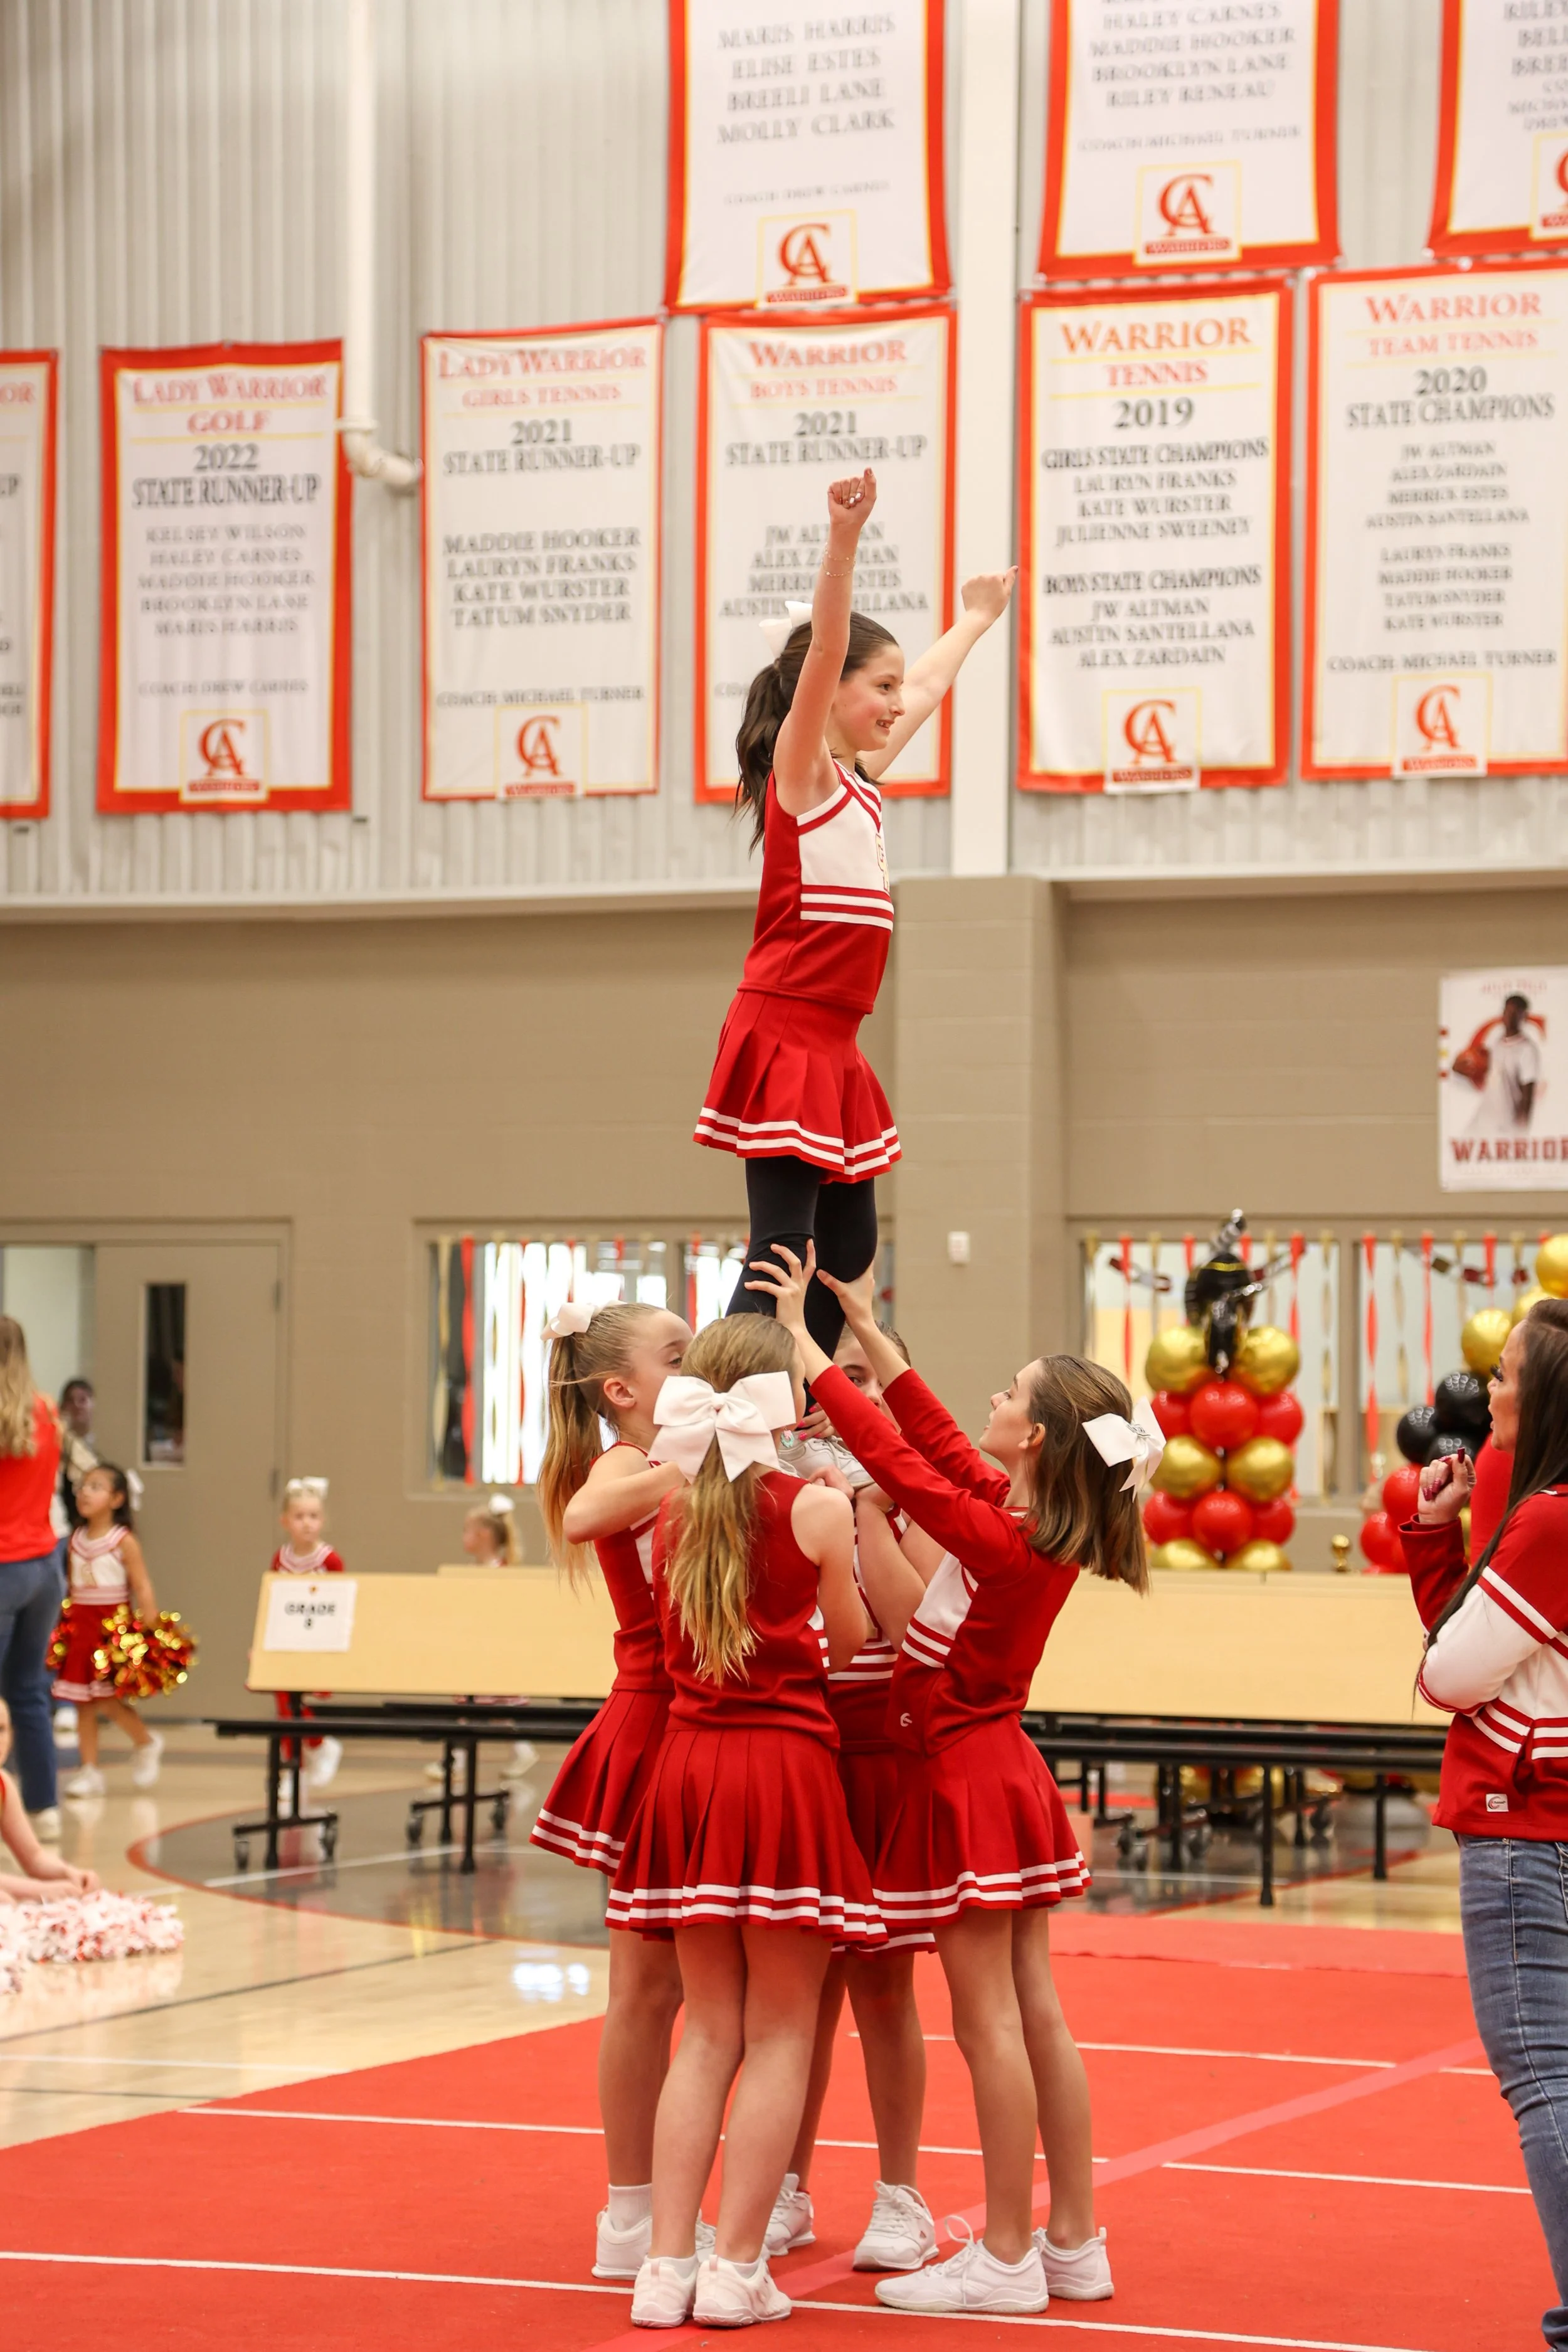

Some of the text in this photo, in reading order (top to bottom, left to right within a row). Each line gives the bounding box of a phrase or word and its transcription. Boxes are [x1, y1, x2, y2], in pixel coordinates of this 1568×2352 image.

[718, 13, 896, 48] MARIS HARRIS
[731, 47, 881, 79] ELISE ESTES
[1227, 53, 1288, 74] LANE
[820, 78, 884, 102] LANE
[717, 109, 896, 144] MOLLY CLARK
[1365, 293, 1542, 323] WARRIOR
[1061, 318, 1251, 352] WARRIOR
[1368, 331, 1538, 357] TEAM TENNIS
[439, 347, 646, 378] LADY WARRIOR
[750, 341, 906, 368] WARRIOR
[1107, 360, 1207, 386] TENNIS
[1415, 366, 1487, 396] 2020
[134, 374, 327, 403] LADY WARRIOR
[463, 385, 621, 406] GIRLS TENNIS
[752, 376, 898, 398] BOYS TENNIS
[188, 411, 270, 433] GOLF
[795, 411, 857, 436] 2021
[1113, 398, 1194, 428] 2019
[1346, 393, 1555, 428] STATE CHAMPIONS
[511, 420, 571, 443] 2021
[193, 444, 259, 471] 2022
[444, 444, 640, 474] STATE RUNNER-UP
[726, 435, 927, 465] STATE RUNNER-UP
[1042, 438, 1269, 468] GIRLS STATE CHAMPIONS
[133, 475, 321, 508] STATE RUNNER-UP
[1157, 469, 1236, 489] FRANKS
[1078, 494, 1231, 517] KATE WURSTER
[444, 527, 641, 554] MADDIE HOOKER
[1159, 517, 1251, 538] SWEENEY
[447, 554, 636, 578] LAURYN FRANKS
[1044, 565, 1261, 593] BOYS STATE CHAMPIONS
[453, 578, 630, 602] KATE WURSTER
[453, 603, 631, 626] TATUM SNYDER
[1091, 597, 1209, 620] JW ALTMAN
[1051, 620, 1254, 644] AUSTIN SANTELLANA
[1079, 649, 1128, 667] ALEX
[1328, 650, 1556, 671] COACH MICHAEL TURNER
[285, 1602, 336, 1615] GRADE
